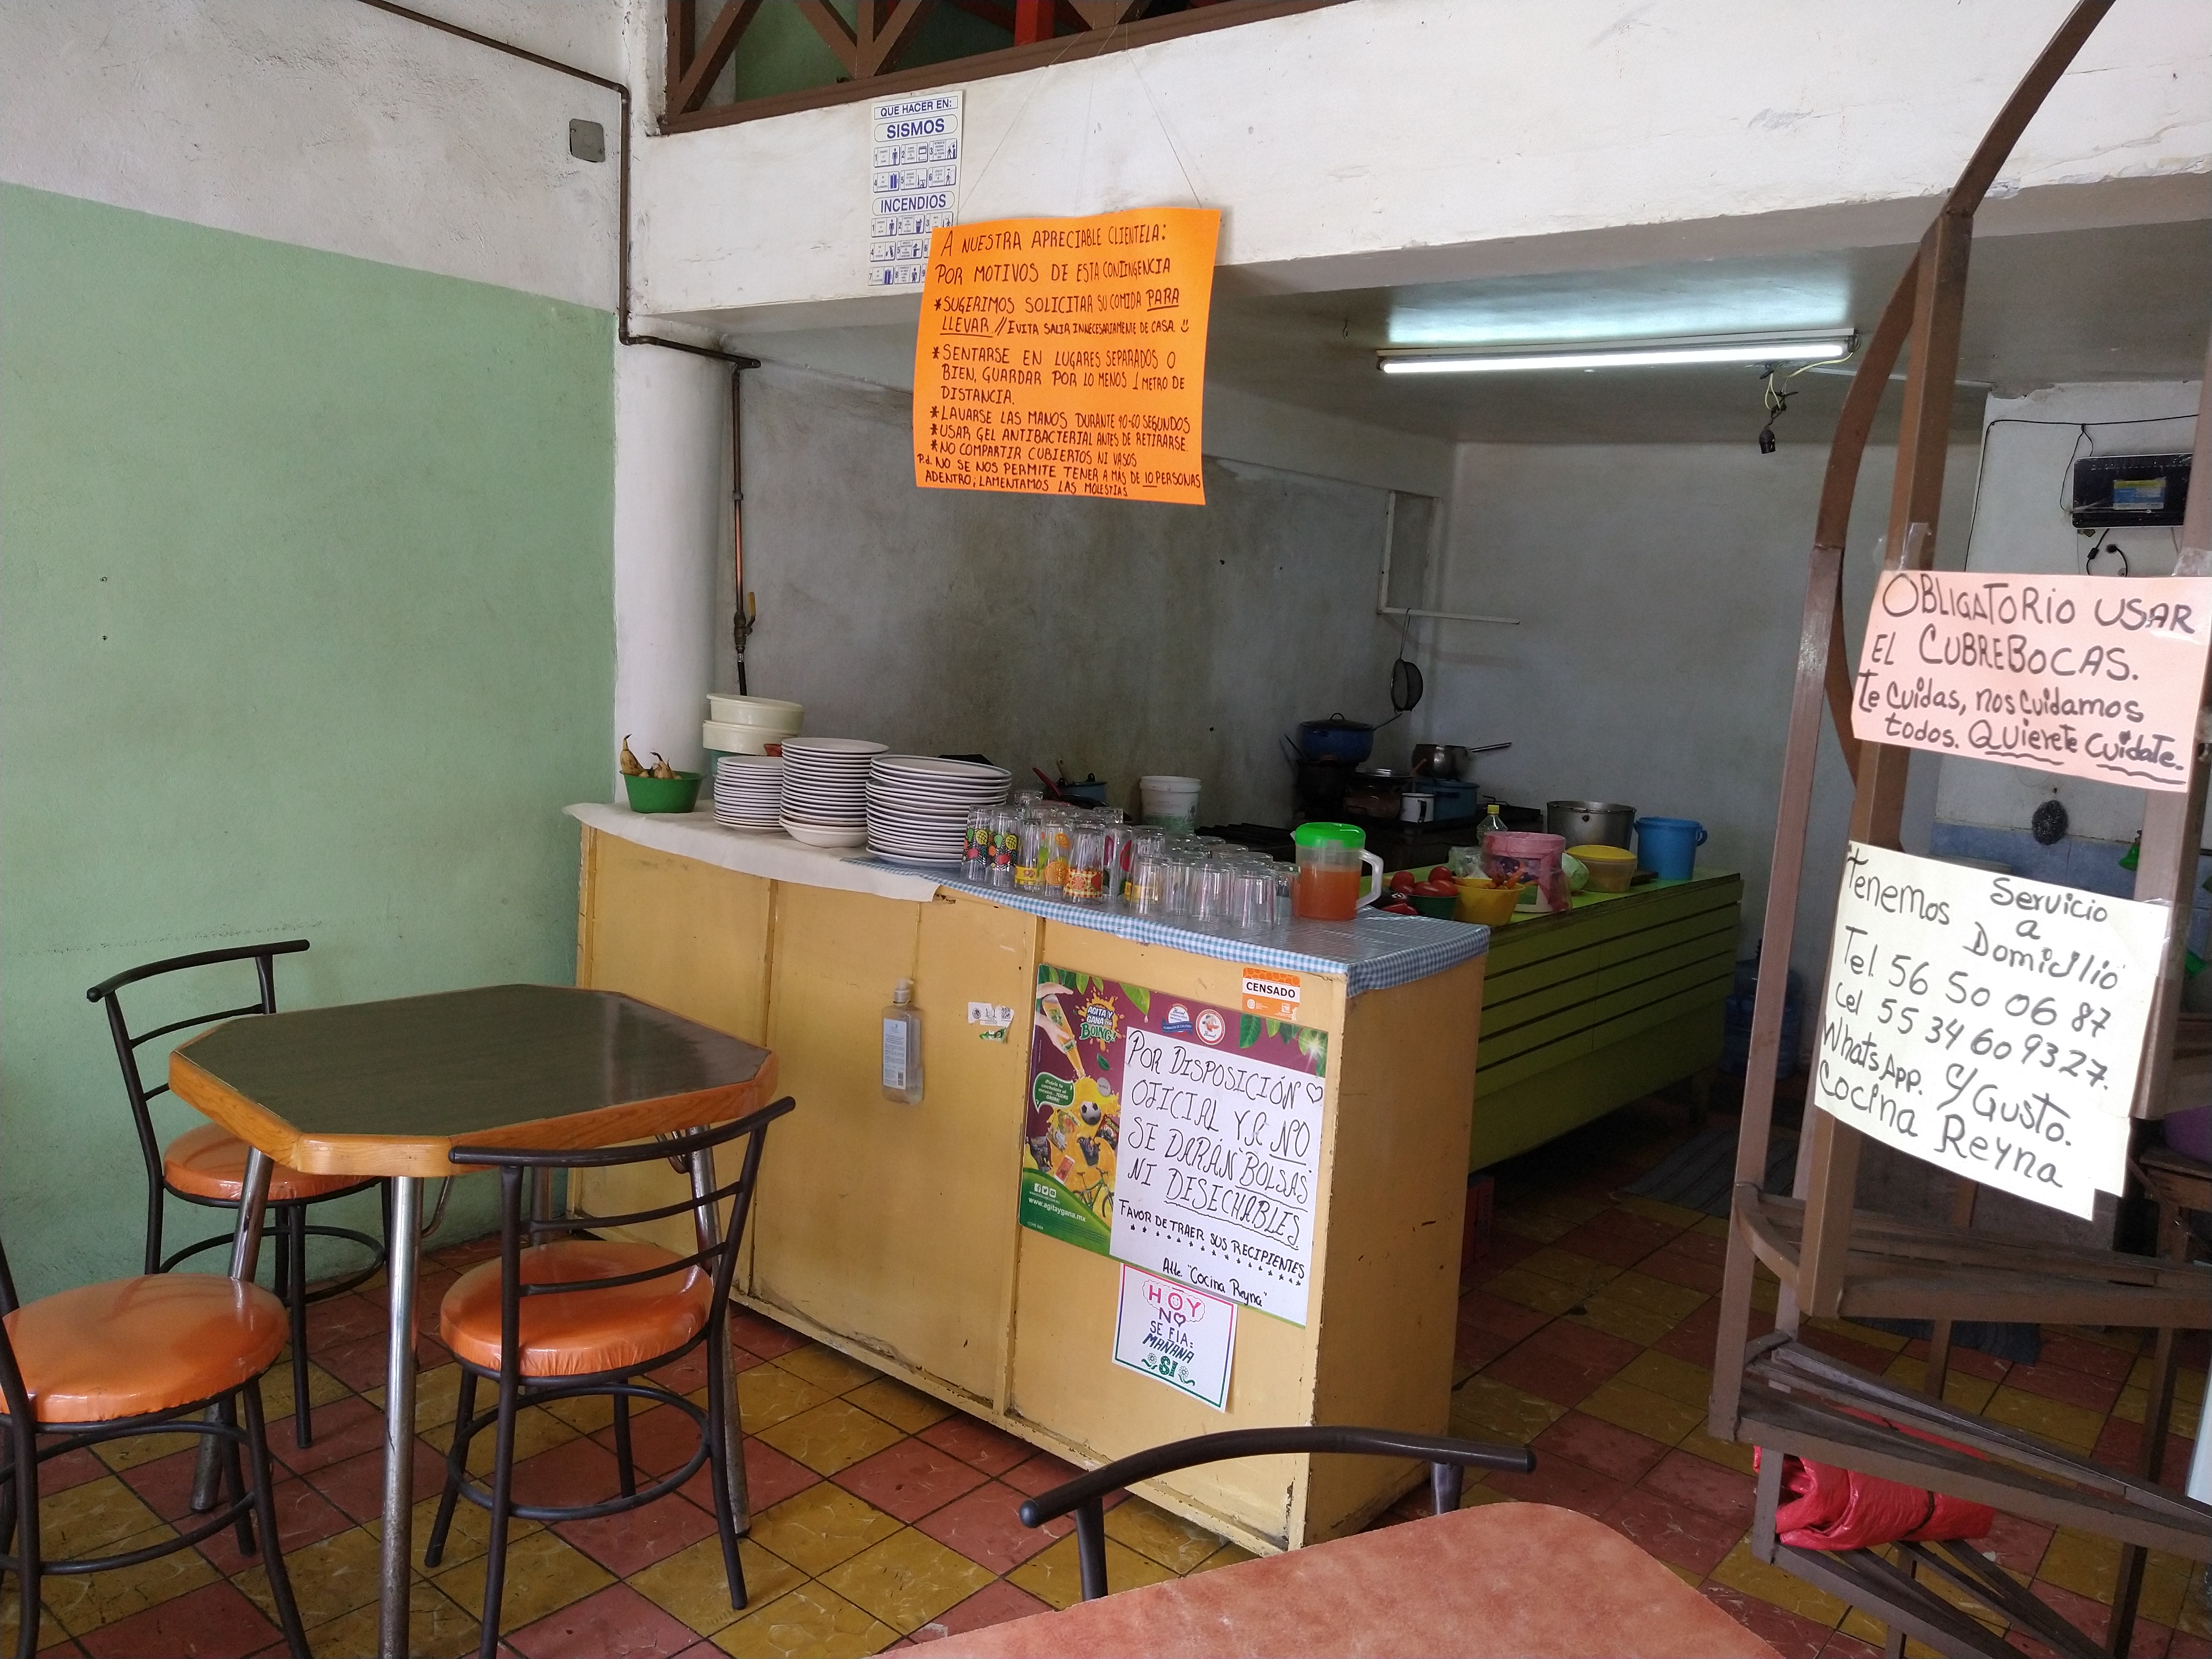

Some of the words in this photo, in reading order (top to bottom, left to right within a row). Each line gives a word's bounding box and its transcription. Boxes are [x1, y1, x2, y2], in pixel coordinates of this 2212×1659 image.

[880, 107, 900, 117] QUE
[902, 101, 933, 114] HACER
[936, 98, 952, 111] EN:
[886, 118, 945, 139] SISMOS
[930, 147, 933, 155] 3
[900, 176, 904, 184] 5
[929, 173, 932, 181] 6
[880, 194, 946, 213] INCENDIOS
[941, 230, 953, 257] A
[962, 231, 1022, 253] NUESTRA
[1031, 228, 1102, 249] APRECIABLE
[1108, 224, 1166, 246] CLIENTELA:
[935, 264, 963, 285] POR
[974, 263, 1039, 283] MOTIVOS
[1051, 263, 1068, 282] DE
[1077, 262, 1099, 283] ESTA
[1025, 295, 1093, 314] SOLICITAR
[1097, 294, 1108, 312] SU
[1110, 291, 1141, 310] COMIDA
[1146, 288, 1180, 307] PARA
[1140, 321, 1149, 334] DE
[1151, 320, 1175, 333] CASA
[1023, 349, 1042, 366] EN
[1055, 351, 1101, 370] LUGARES
[1106, 348, 1159, 369] SEPARADOS
[1167, 351, 1176, 369] O
[941, 363, 977, 383] BIEN,
[982, 366, 1042, 385] GUARDAR
[1051, 370, 1077, 388] POR
[1083, 372, 1094, 387] LO
[1098, 371, 1127, 388] MENOS
[1132, 372, 1139, 390] 1
[1142, 376, 1168, 392] METRO
[1172, 375, 1185, 390] DE
[941, 385, 1015, 405] DISTANCIA.
[1000, 411, 1022, 425] LAS
[1028, 411, 1068, 429] MANOS
[1074, 413, 1115, 429] DURANTE
[1142, 414, 1191, 434] SEGUNDOS
[976, 426, 996, 442] GEL
[1002, 428, 1093, 446] ANTIBACTERIAL
[1097, 432, 1119, 447] ANTES
[1122, 432, 1131, 446] DE
[959, 443, 1022, 460] COMPARTIR
[1028, 447, 1092, 465] CUBIERTOS
[1097, 451, 1108, 465] NI
[1113, 452, 1138, 467] VASOS
[935, 456, 951, 469] NO
[957, 460, 971, 472] SE
[976, 461, 998, 473] NOS
[1003, 462, 1057, 478] PERMITE
[1063, 466, 1099, 482] TENER
[1103, 469, 1108, 482] A
[1130, 471, 1141, 484] DE
[1145, 471, 1154, 484] 10
[1156, 471, 1201, 488] PERSONAS
[979, 476, 1049, 492] LAMENTAMOS
[1058, 481, 1077, 494] LAS
[2094, 597, 2195, 634] USAR
[1871, 631, 1897, 665] EL
[1858, 669, 1880, 713] Te
[1976, 688, 2016, 715] nos
[2015, 919, 2041, 940] a
[1246, 982, 1296, 998] CENSADO
[1888, 953, 1930, 995] 56
[1944, 970, 1991, 1007] 50
[2004, 993, 2058, 1026] 06
[2070, 1001, 2112, 1038] 87
[1087, 1006, 1107, 1018] AGITA
[1107, 1010, 1114, 1019] Y
[1087, 1015, 1104, 1025] GANA
[1835, 981, 1863, 1016] Cel
[1877, 997, 1919, 1035] 55
[1924, 1015, 1965, 1051] 34
[1079, 1022, 1117, 1043] BOING!
[1128, 1030, 1162, 1074] POR
[1168, 1046, 1302, 1110] DISPOSICIÓN
[1128, 1117, 1159, 1151] SE
[1819, 1058, 1919, 1138] Cocina
[1933, 1113, 2064, 1188] Reyna
[1270, 1118, 1311, 1157] NO
[1127, 1157, 1157, 1186] NI
[1028, 1197, 1087, 1223] www.agitaygana.mx
[1118, 1198, 1152, 1223] FAVOR
[1155, 1215, 1167, 1229] DE
[1169, 1220, 1205, 1241] TRAER
[1210, 1232, 1227, 1251] SUS
[1230, 1240, 1305, 1279] RECIPIENTES
[1149, 1284, 1202, 1318] HOY
[1150, 1320, 1163, 1336] SE
[1159, 1355, 1178, 1378] SI
